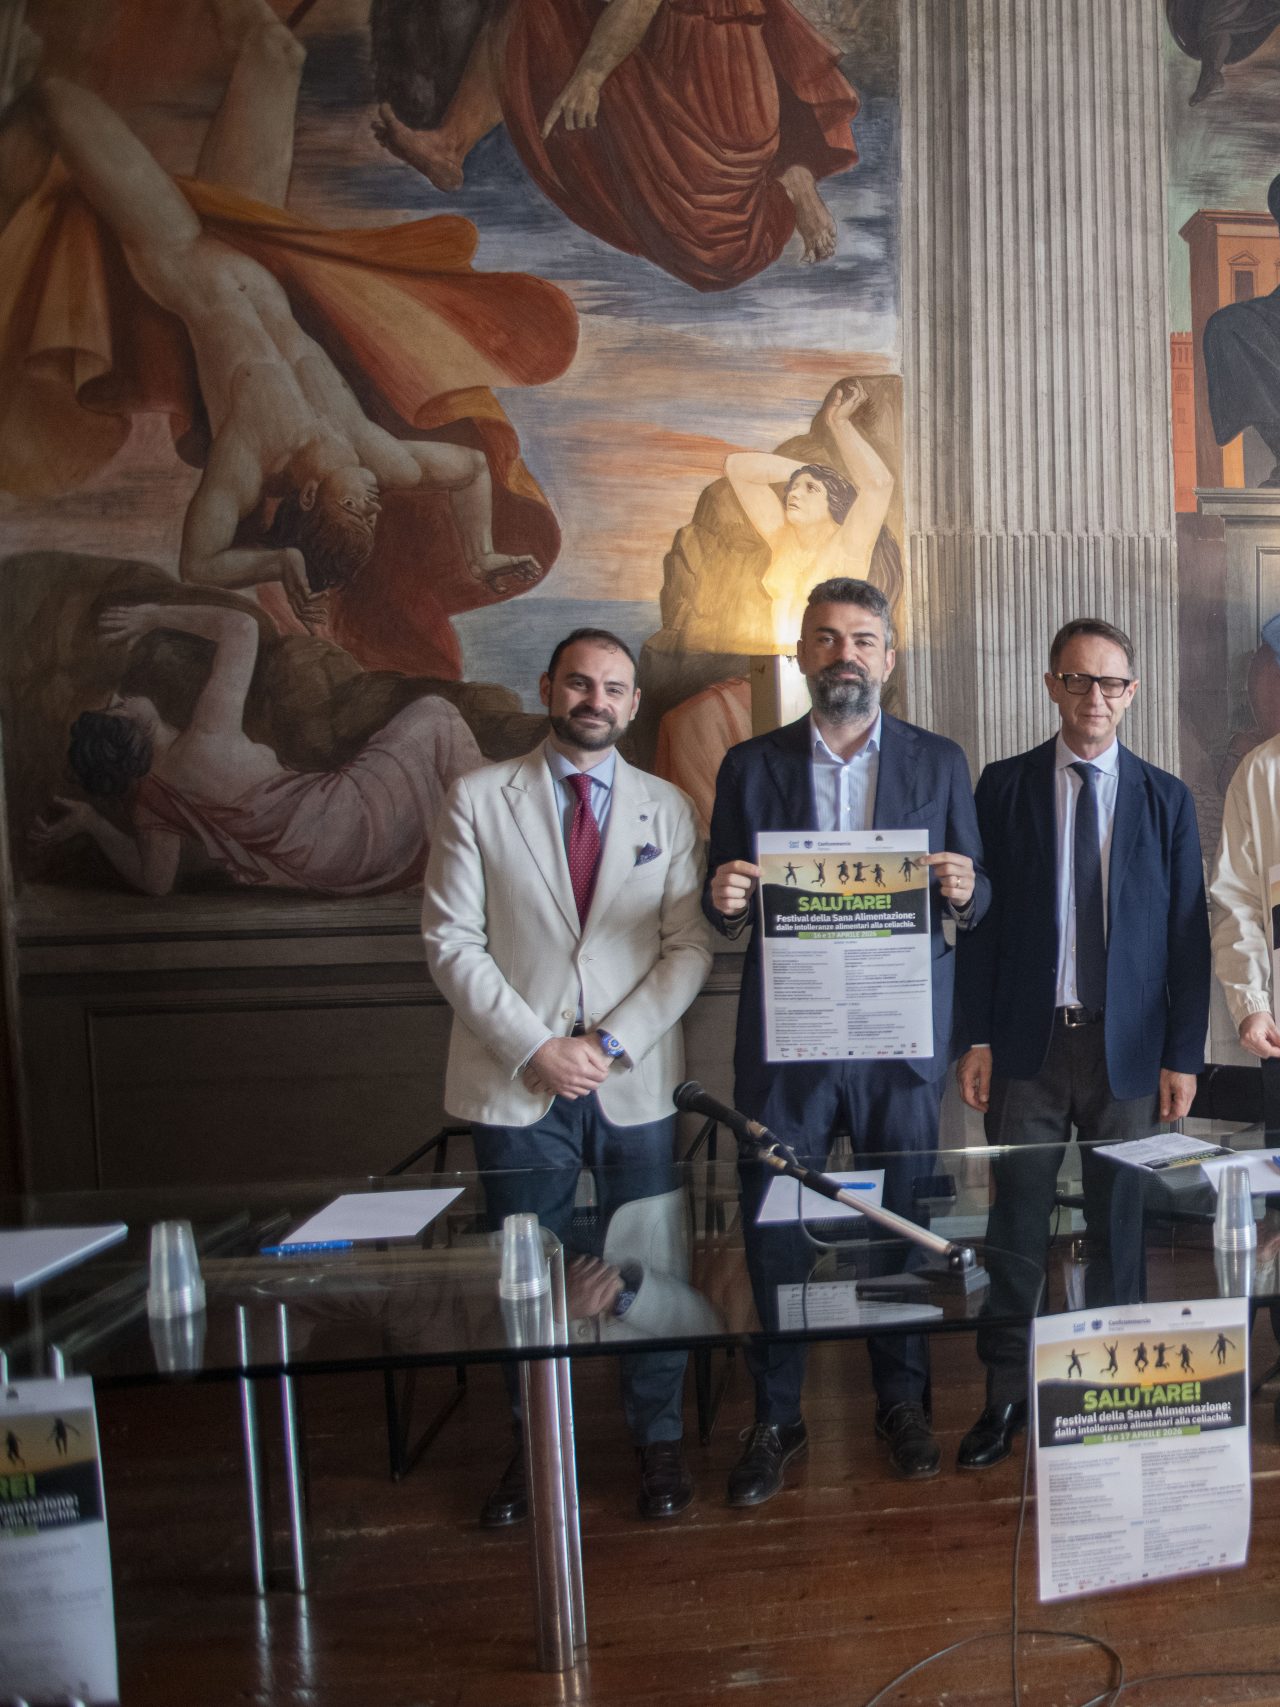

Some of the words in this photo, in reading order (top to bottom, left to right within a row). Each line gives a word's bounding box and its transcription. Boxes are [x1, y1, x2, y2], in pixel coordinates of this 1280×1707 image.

[798, 894, 892, 912] SALUTARE!
[776, 914, 809, 922] Festival
[811, 914, 831, 922] della
[855, 912, 915, 921] Alimentazione:
[1084, 1382, 1200, 1410] SALUTARE!
[1055, 1426, 1077, 1438] dalle
[1078, 1423, 1128, 1435] intolleranze
[1130, 1417, 1173, 1430] alimentari
[1174, 1415, 1190, 1425] alla
[1192, 1412, 1231, 1424] celiachia.
[1056, 1412, 1097, 1427] Festival
[1099, 1410, 1124, 1422] della
[1127, 1409, 1153, 1420] Sana
[1155, 1401, 1231, 1417] Alimentazione:
[1103, 1434, 1112, 1442] 16
[1131, 1430, 1160, 1439] APRILE
[1163, 1428, 1182, 1437] 2026
